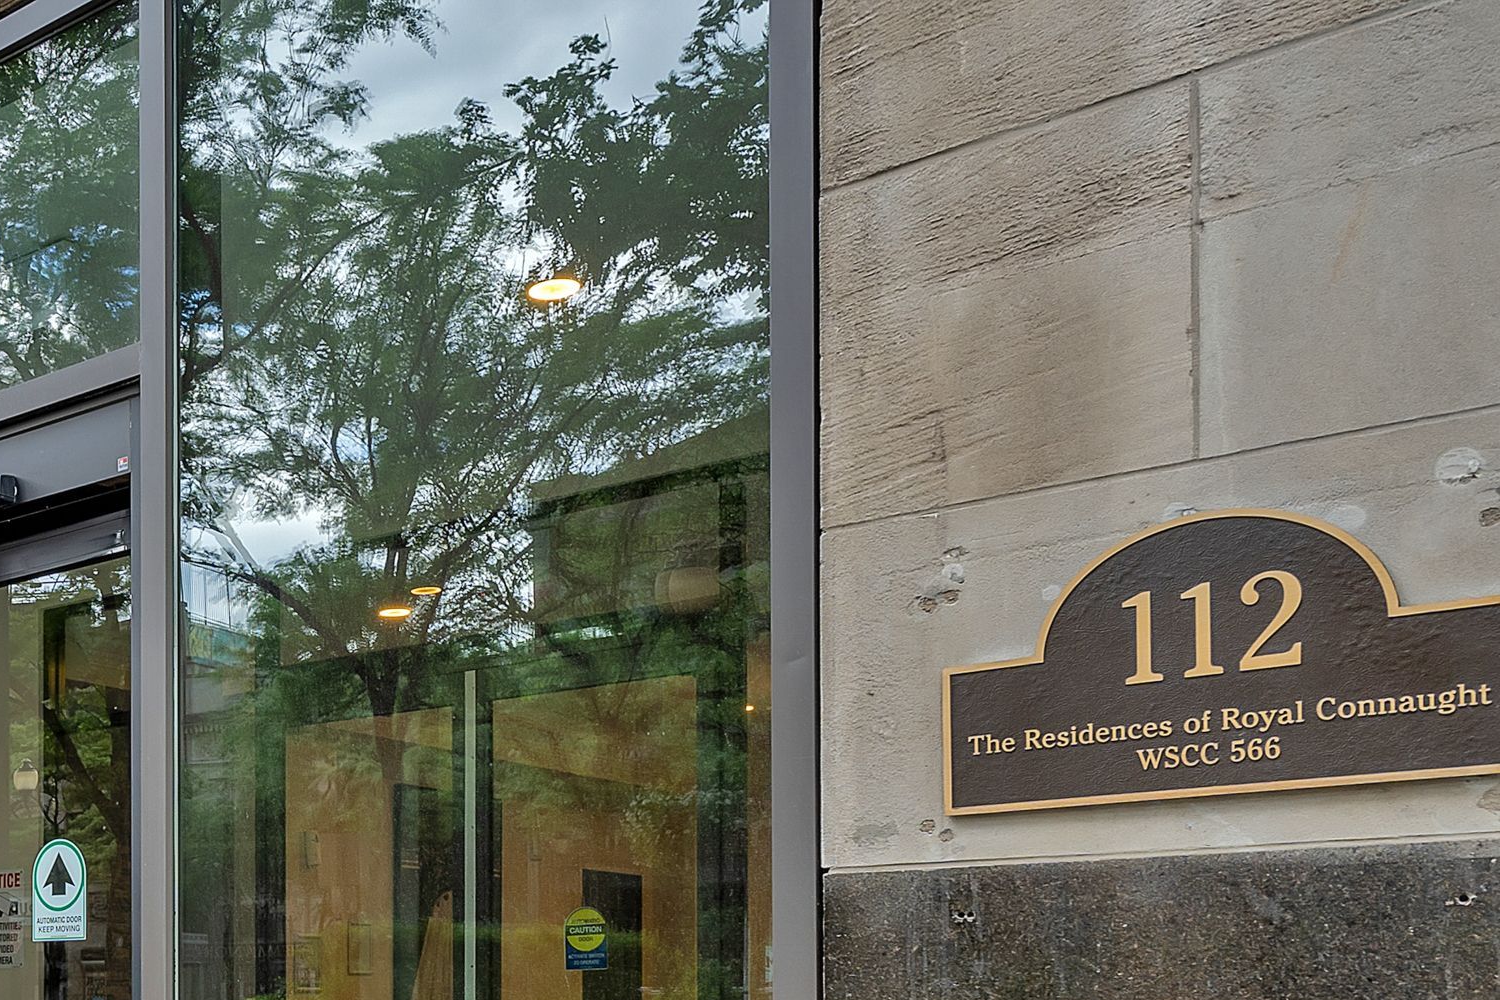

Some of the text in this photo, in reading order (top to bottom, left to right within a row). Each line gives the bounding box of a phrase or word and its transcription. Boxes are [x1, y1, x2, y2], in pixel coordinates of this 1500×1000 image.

[1121, 570, 1303, 685] 112
[968, 683, 1492, 756] The Residences of Royal Connaught
[1135, 736, 1282, 770] WSCC 566
[37, 915, 82, 925] AUTOMATIC DOOR
[38, 924, 81, 933] KEEP MOVING
[569, 925, 602, 934] CAUTION
